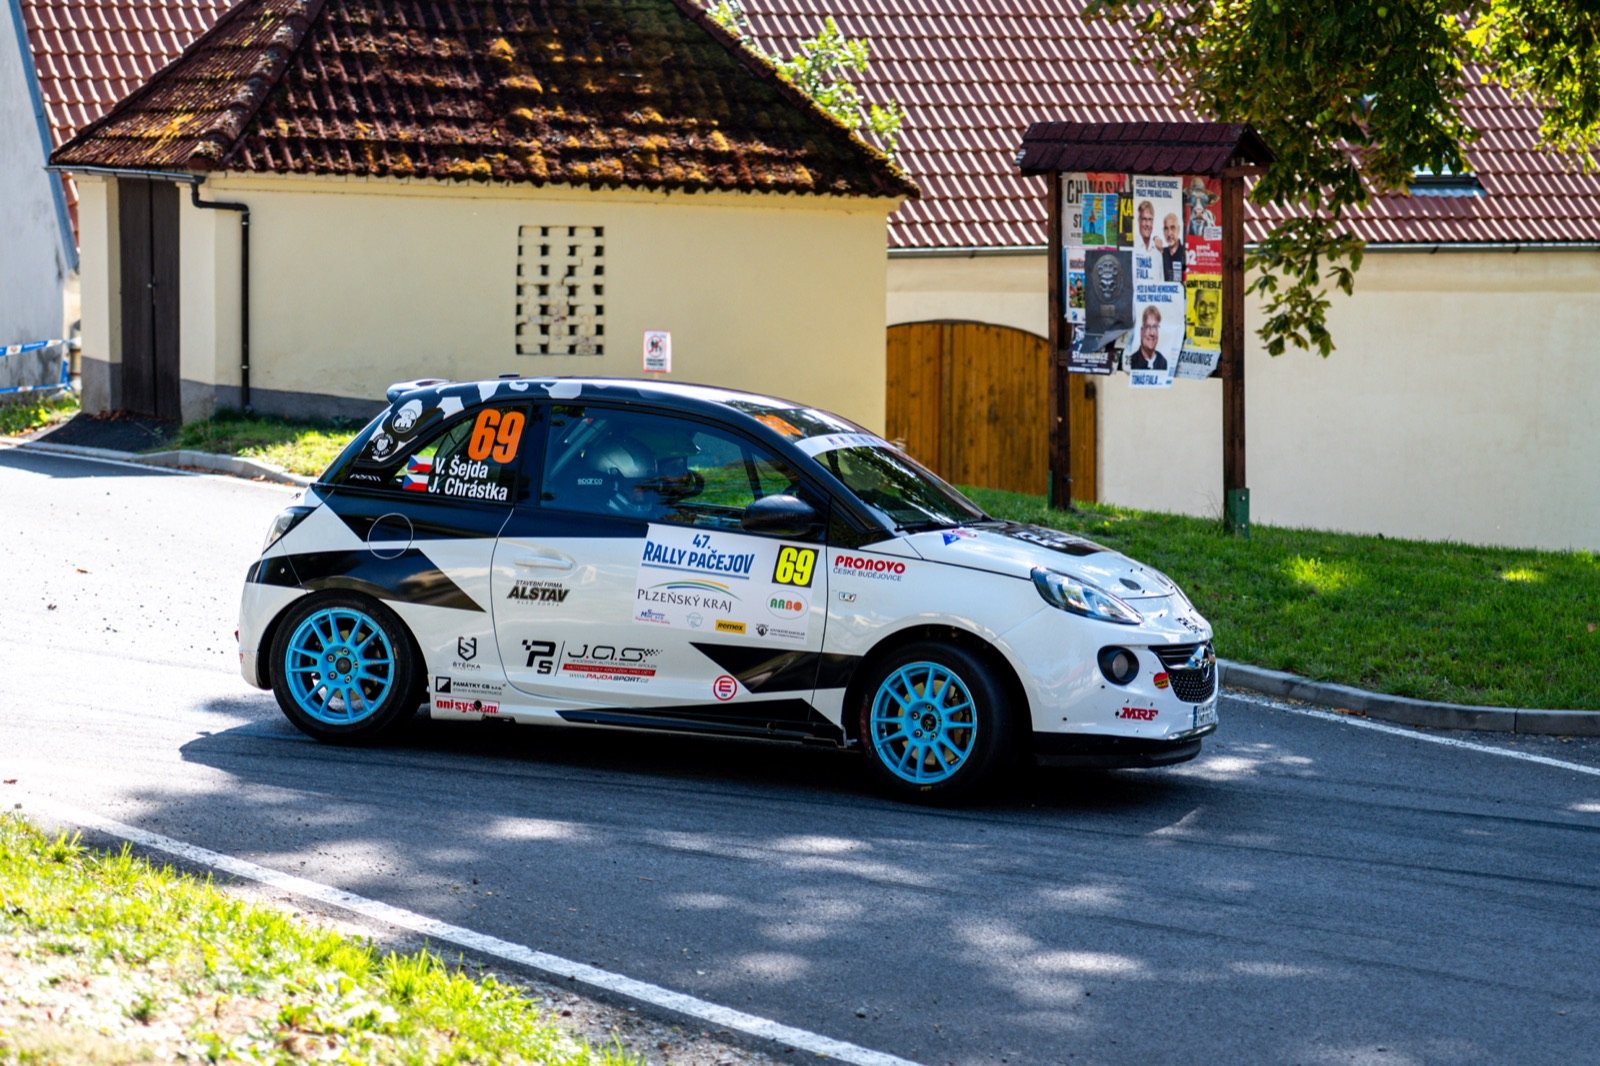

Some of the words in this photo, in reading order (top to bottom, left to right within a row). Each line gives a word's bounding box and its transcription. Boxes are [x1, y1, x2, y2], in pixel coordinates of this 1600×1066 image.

[468, 408, 525, 464] 69
[435, 457, 446, 475] V.
[448, 455, 489, 479] Šejda
[428, 477, 441, 494] J.
[444, 477, 508, 501] Chrástka
[692, 534, 711, 549] 47.
[642, 541, 687, 565] RALLY
[688, 549, 756, 575] PAČEJOV
[775, 546, 817, 586] 69
[835, 555, 906, 574] PRONOVO
[833, 567, 856, 578] ČESKÉ
[857, 569, 902, 582] BUDĚJOVICE
[506, 585, 571, 603] ALSTAV
[637, 588, 702, 608] PLZEŇSKÝ
[703, 597, 733, 614] KRAJ
[770, 598, 802, 612] ARBO
[1119, 707, 1159, 721] MRF
